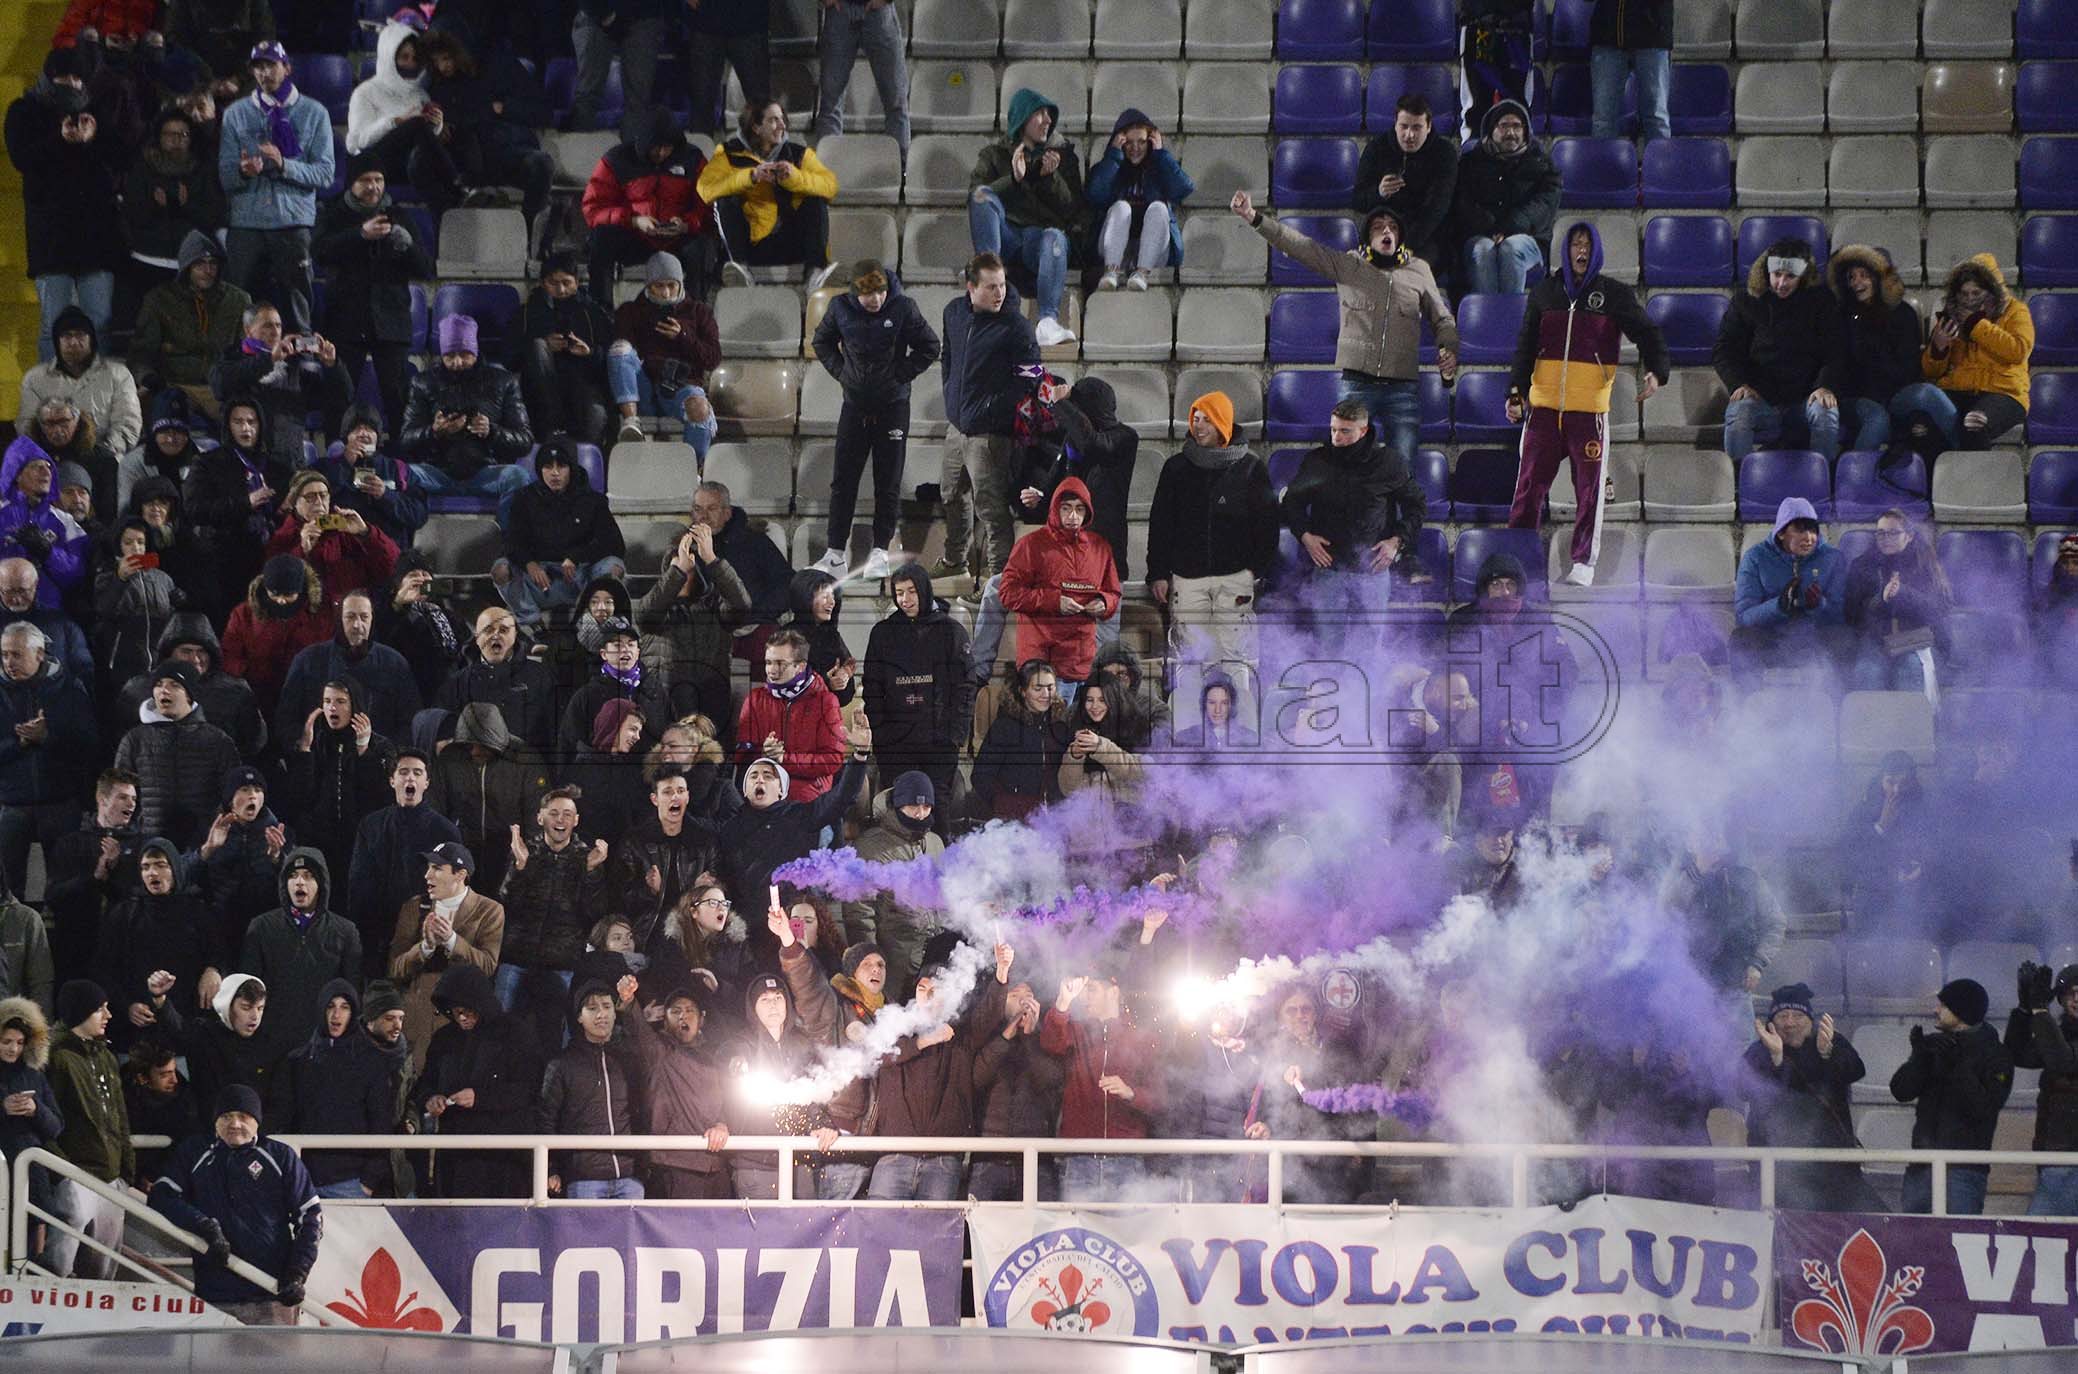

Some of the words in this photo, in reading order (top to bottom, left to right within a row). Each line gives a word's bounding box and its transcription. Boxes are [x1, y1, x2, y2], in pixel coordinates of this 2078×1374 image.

[31, 1288, 115, 1310] viola
[132, 1294, 206, 1314] club
[471, 1247, 931, 1344] GORIZIA
[994, 1233, 1076, 1292] VIOLA
[1084, 1237, 1148, 1297] CLUB
[1160, 1237, 1480, 1307] VIOLA
[1503, 1227, 1759, 1311] CLUB
[1951, 1232, 2078, 1304] VI
